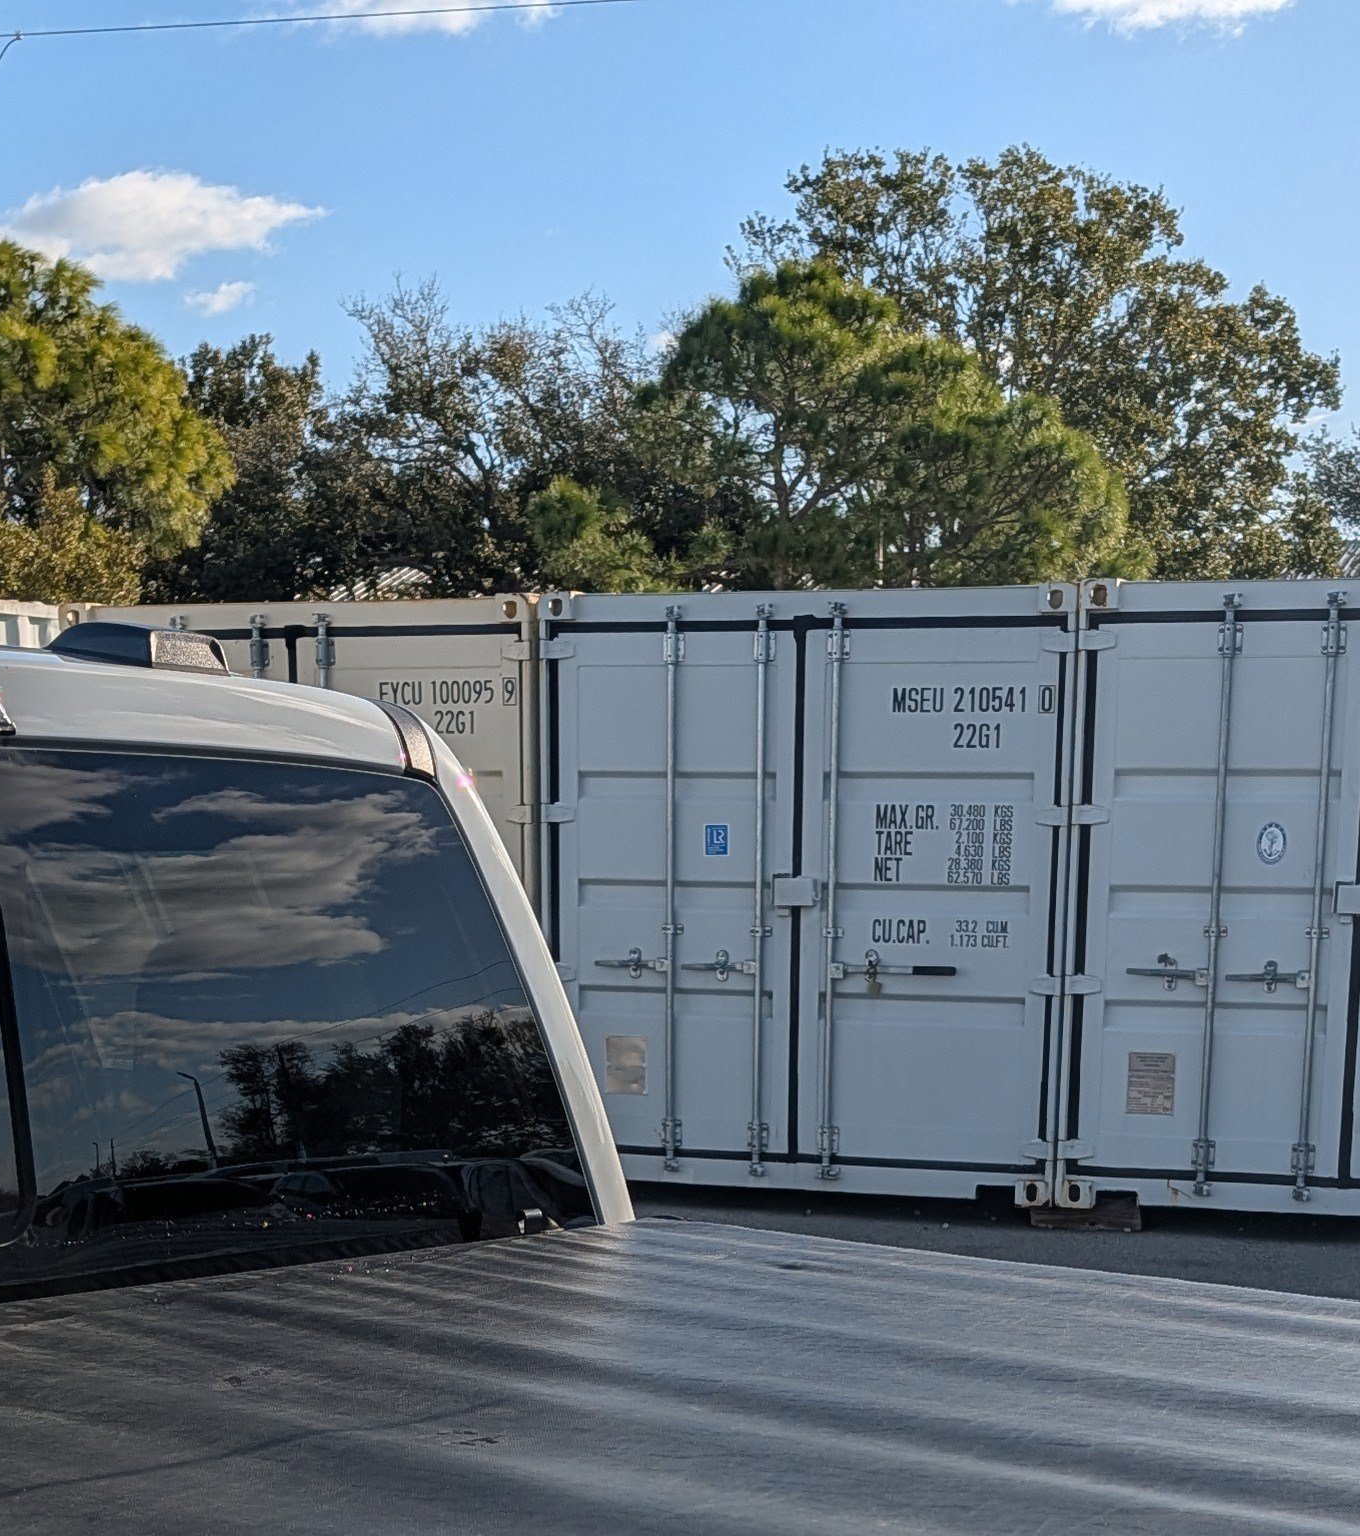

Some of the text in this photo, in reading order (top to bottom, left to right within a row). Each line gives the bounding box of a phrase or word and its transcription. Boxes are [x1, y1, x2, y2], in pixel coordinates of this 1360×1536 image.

[430, 679, 495, 705] 100095
[503, 678, 516, 704] 9
[892, 686, 1055, 713] MSEU 210541 0
[433, 709, 475, 735] 22G1
[952, 722, 1002, 749] 22G1
[875, 804, 1014, 830] MAX.GR. 30.480 KGS
[949, 817, 1013, 832] 67.200 LBS
[875, 831, 1013, 856] TARE 2.100 KGS
[954, 844, 1012, 859] 4.630 LBS
[873, 857, 1011, 882] NET 28.380 KGS
[990, 872, 1010, 886] LBS
[955, 920, 978, 934] 33.2
[950, 934, 978, 948] 1.173
